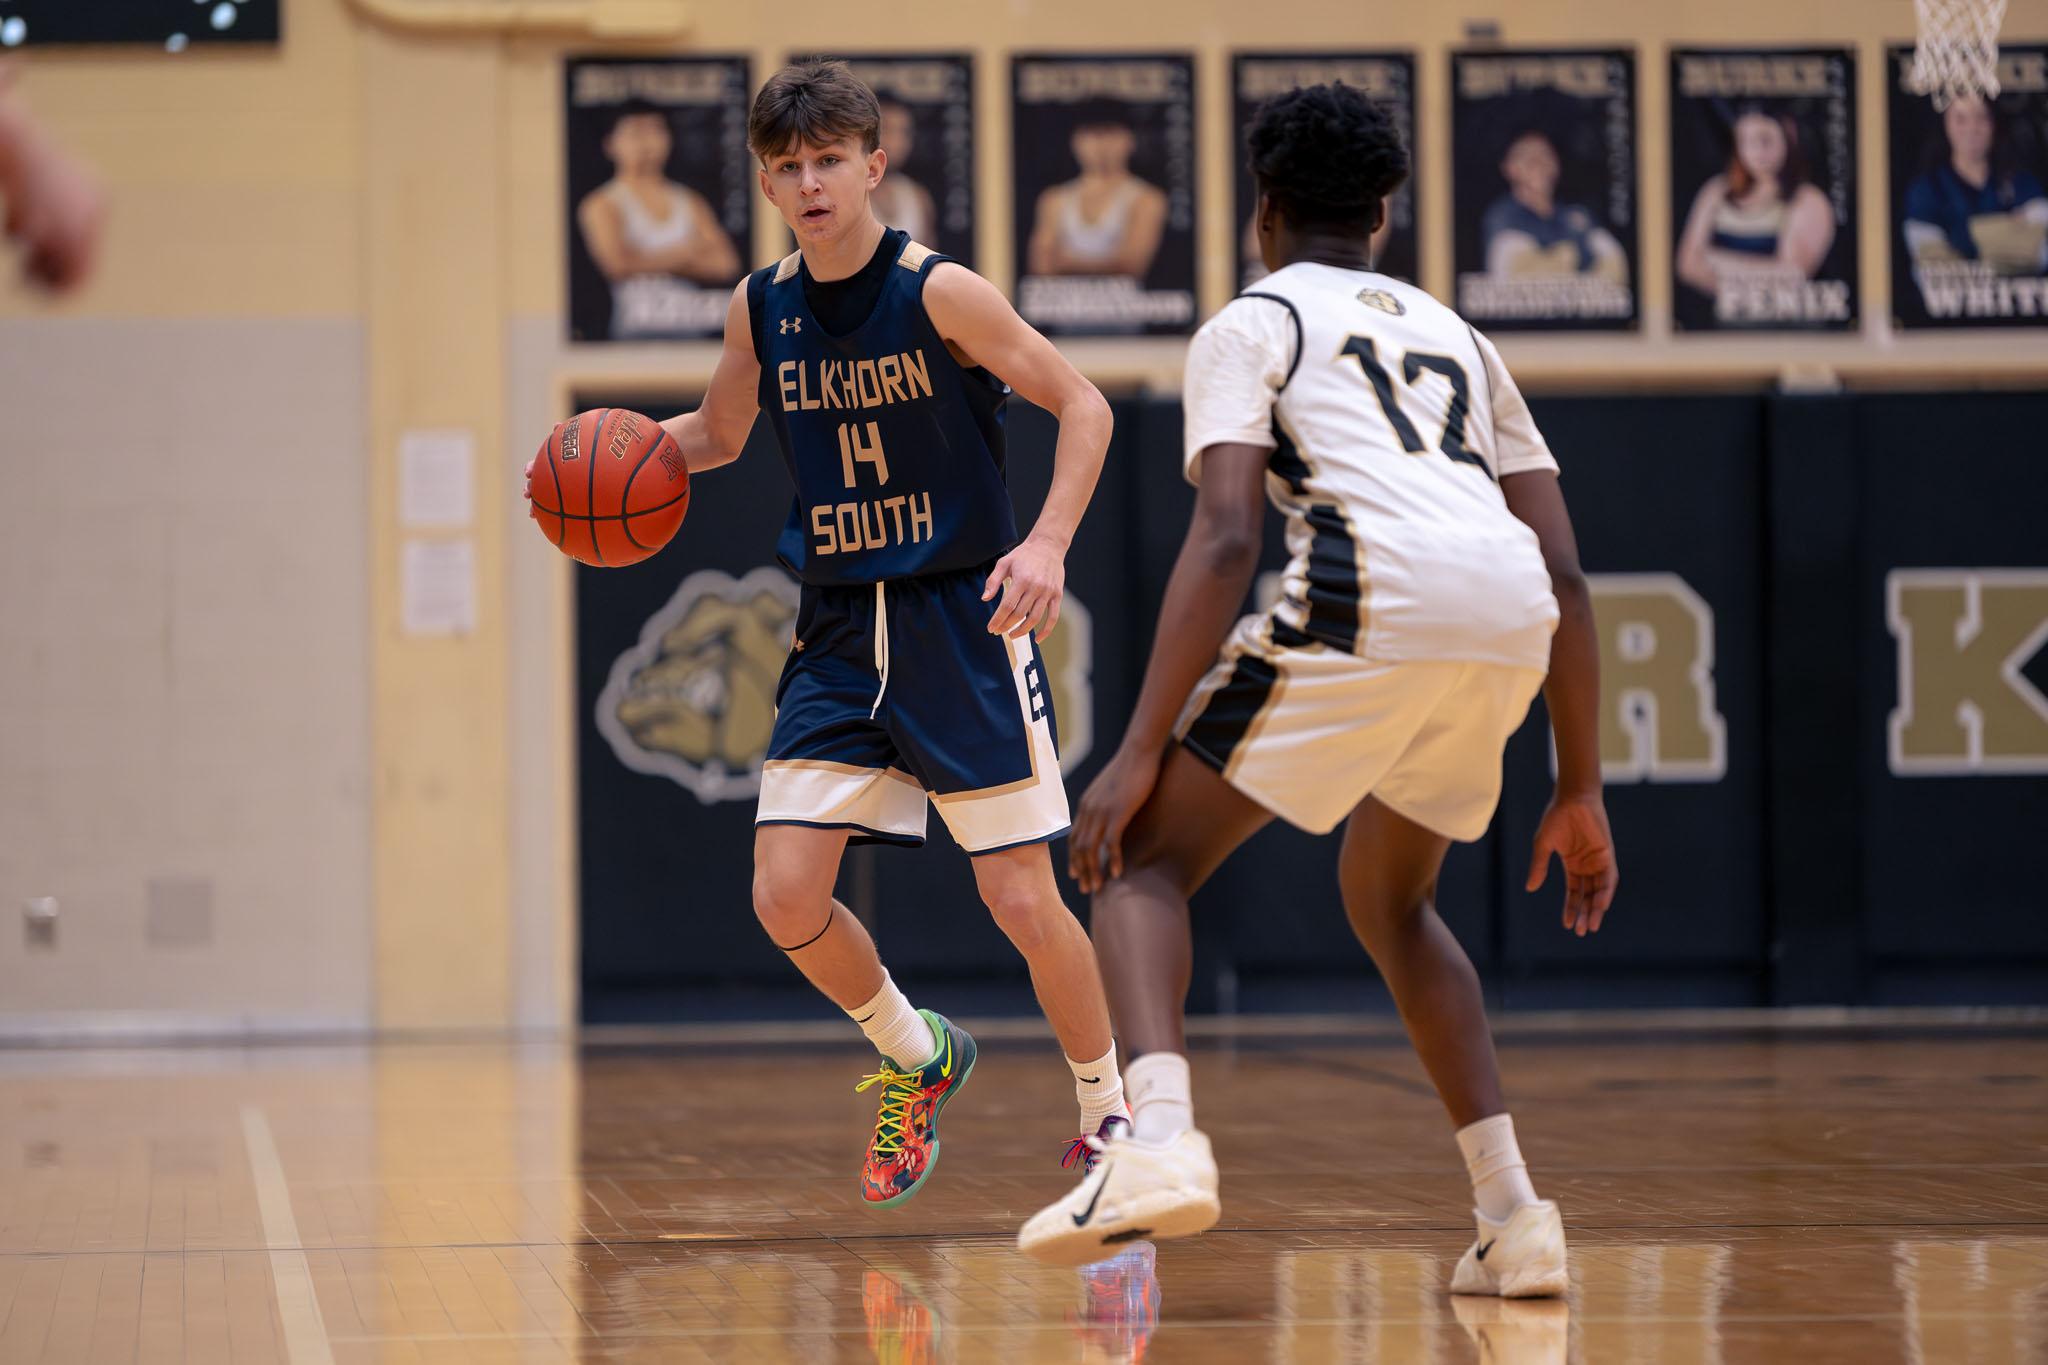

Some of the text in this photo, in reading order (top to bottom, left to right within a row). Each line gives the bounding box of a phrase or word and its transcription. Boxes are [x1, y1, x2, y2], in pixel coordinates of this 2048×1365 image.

[1716, 280, 1849, 321] FENIX
[778, 349, 934, 412] ELKHORN
[1333, 331, 1498, 487] 12
[837, 421, 889, 488] 14
[811, 491, 933, 556] SOUTH
